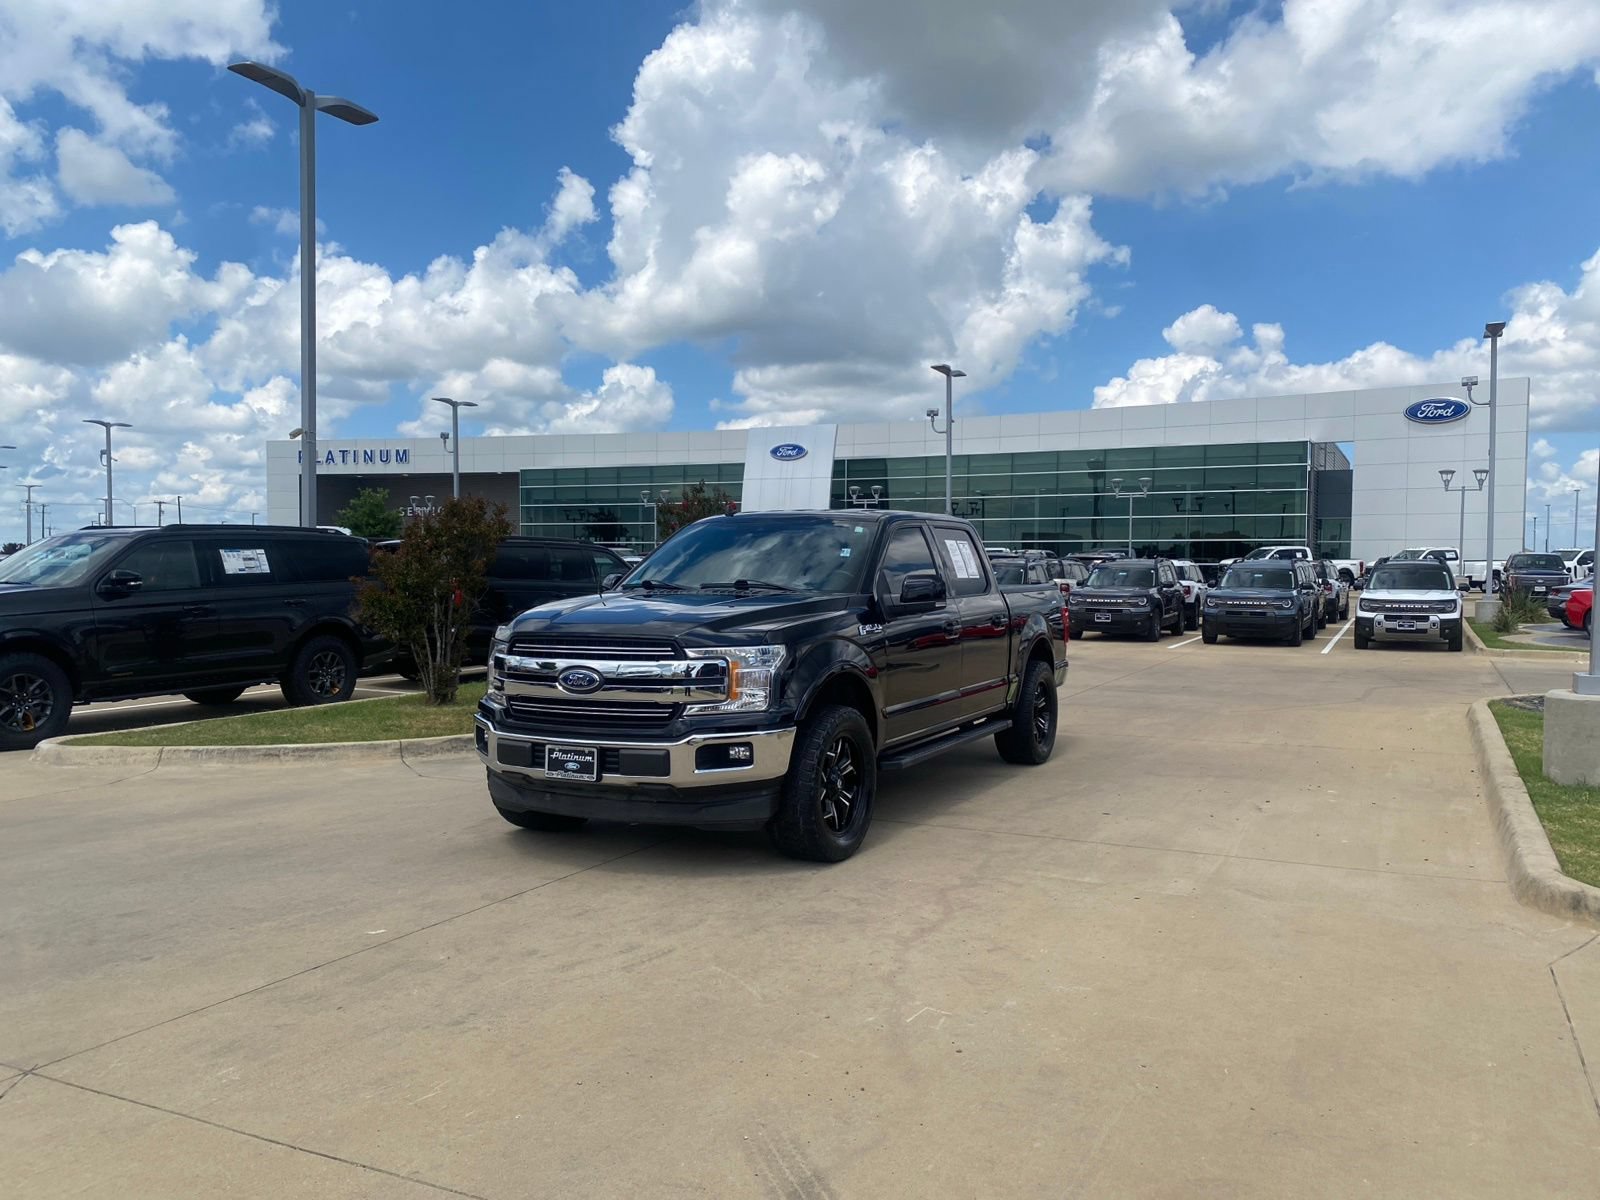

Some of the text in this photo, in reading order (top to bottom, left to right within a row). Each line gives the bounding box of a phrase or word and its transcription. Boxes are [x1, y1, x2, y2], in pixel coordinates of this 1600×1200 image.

[1417, 402, 1455, 418] Ford
[298, 449, 409, 464] ATINUM
[776, 446, 799, 456] Ford
[567, 673, 590, 686] Ford
[550, 751, 595, 762] Platinum
